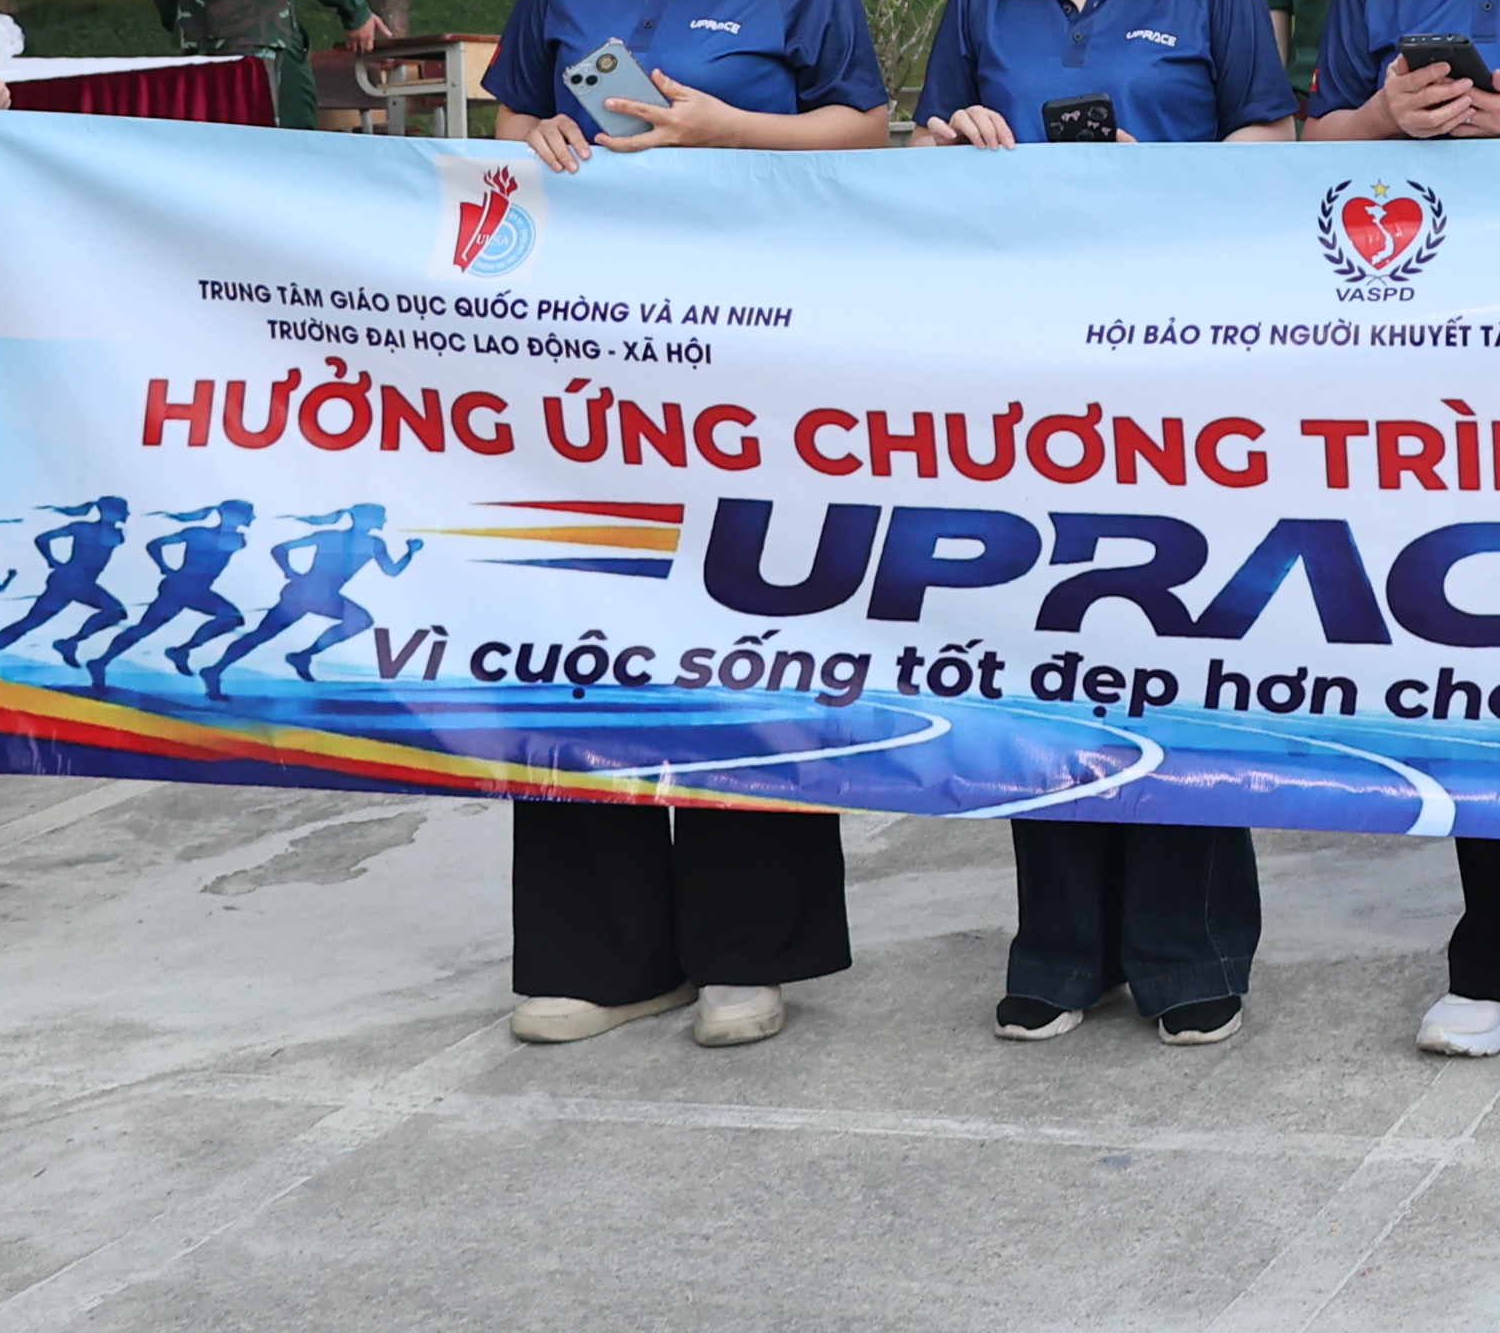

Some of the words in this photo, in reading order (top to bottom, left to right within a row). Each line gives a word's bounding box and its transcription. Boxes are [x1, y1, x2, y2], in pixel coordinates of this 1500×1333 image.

[690, 19, 741, 34] UPRACE
[1126, 29, 1177, 47] UPRACE
[198, 280, 271, 303] TRUNG
[277, 282, 323, 308] TÂM
[330, 287, 389, 312] GIÁO
[397, 294, 446, 318] DỤC
[455, 290, 528, 319] QUỐC
[538, 296, 629, 322] PHÒNG
[641, 299, 672, 323] VÀ
[682, 305, 719, 324] AN
[728, 307, 792, 327] NINH
[1336, 287, 1415, 302] VASPD
[267, 317, 359, 344] TRƯỜNG
[366, 327, 405, 353] ĐẠI
[413, 330, 466, 356] HỌC
[474, 334, 519, 355] LAO
[527, 333, 600, 363] ĐỘNG
[623, 337, 658, 362] XÃ
[667, 337, 711, 364] HỘI
[1087, 319, 1135, 350] HỘI
[1144, 317, 1200, 344] BẢO
[1211, 322, 1261, 351] TRỢ
[1270, 319, 1359, 345] NGƯỜI
[1371, 316, 1471, 347] KHUYẾT
[143, 356, 514, 455] HƯỞNG
[544, 378, 760, 471] ỨNG
[795, 403, 1267, 488] CHƯƠNG
[373, 625, 448, 681] Vì
[469, 633, 655, 700] cuộc
[672, 630, 872, 707] sống
[896, 639, 1004, 700] tốt
[1029, 649, 1179, 719] đẹp
[1204, 658, 1376, 717] hơn
